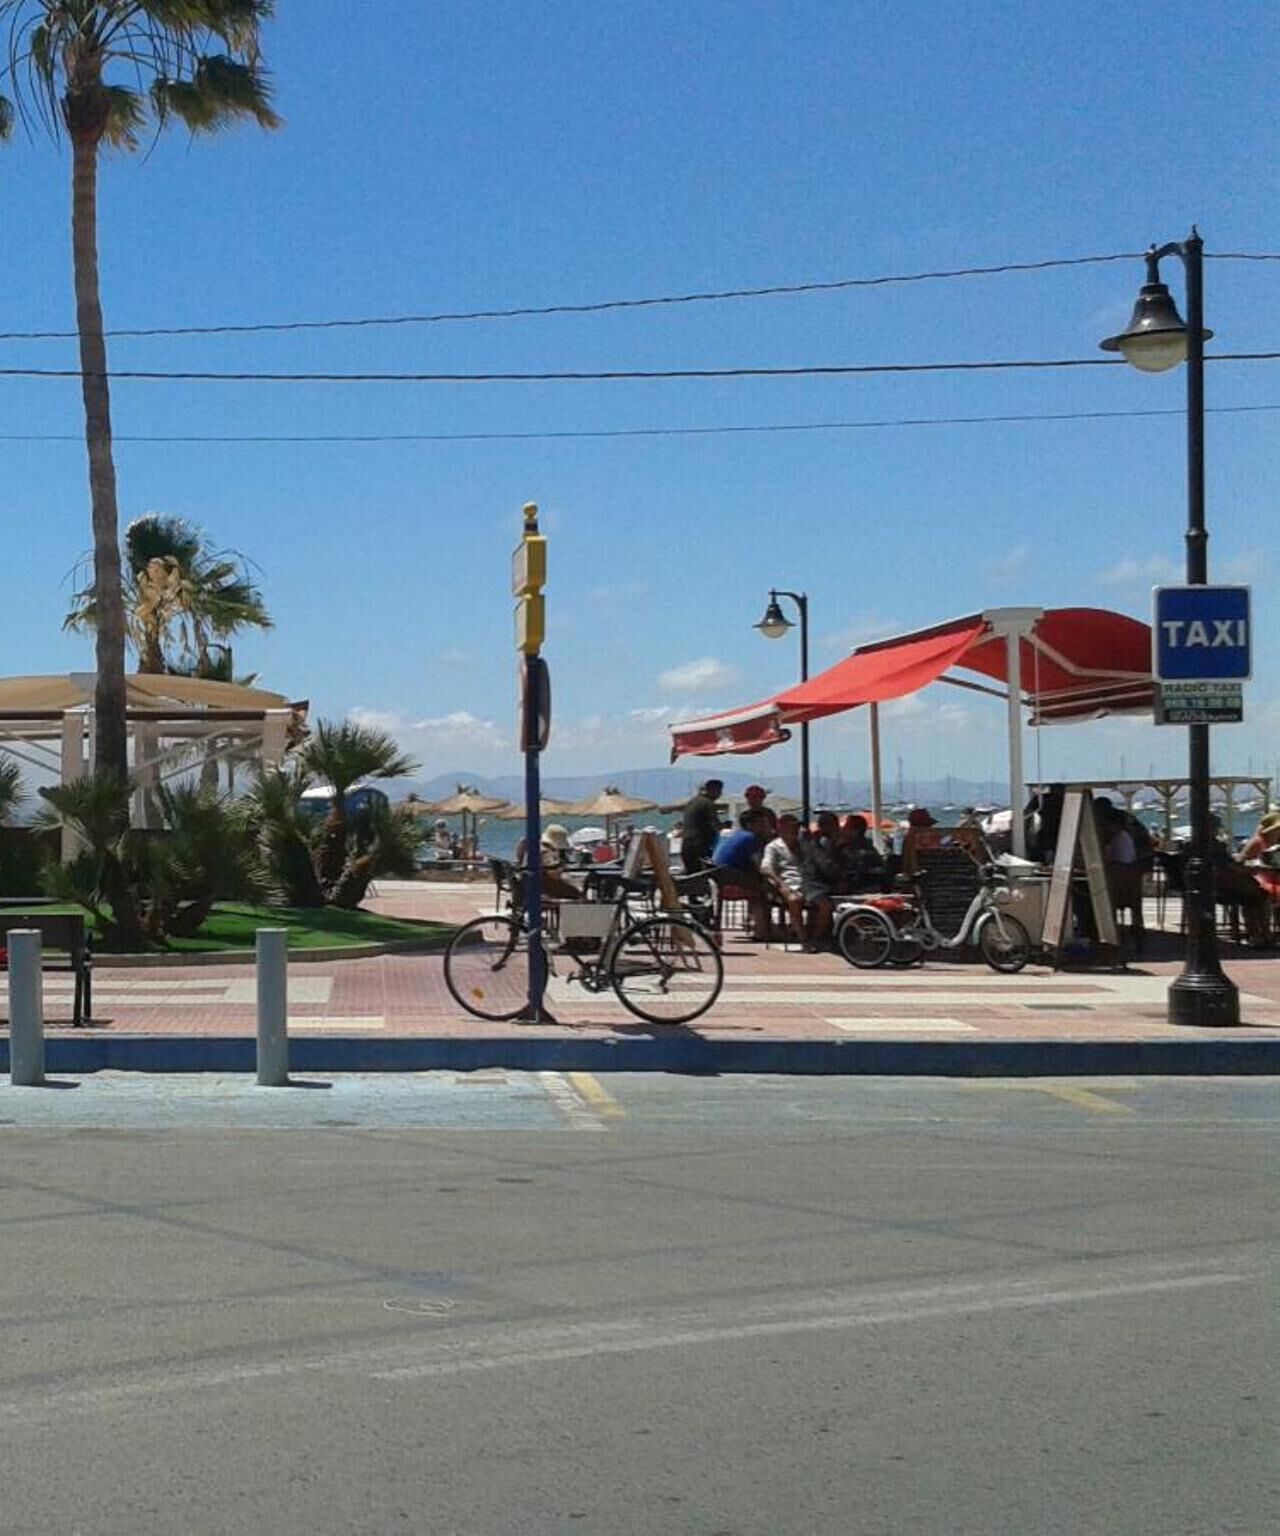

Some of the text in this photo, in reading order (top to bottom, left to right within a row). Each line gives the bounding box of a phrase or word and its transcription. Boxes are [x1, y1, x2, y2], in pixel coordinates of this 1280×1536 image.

[1162, 620, 1245, 647] TAXI
[1164, 682, 1242, 693] RADIO TAXI
